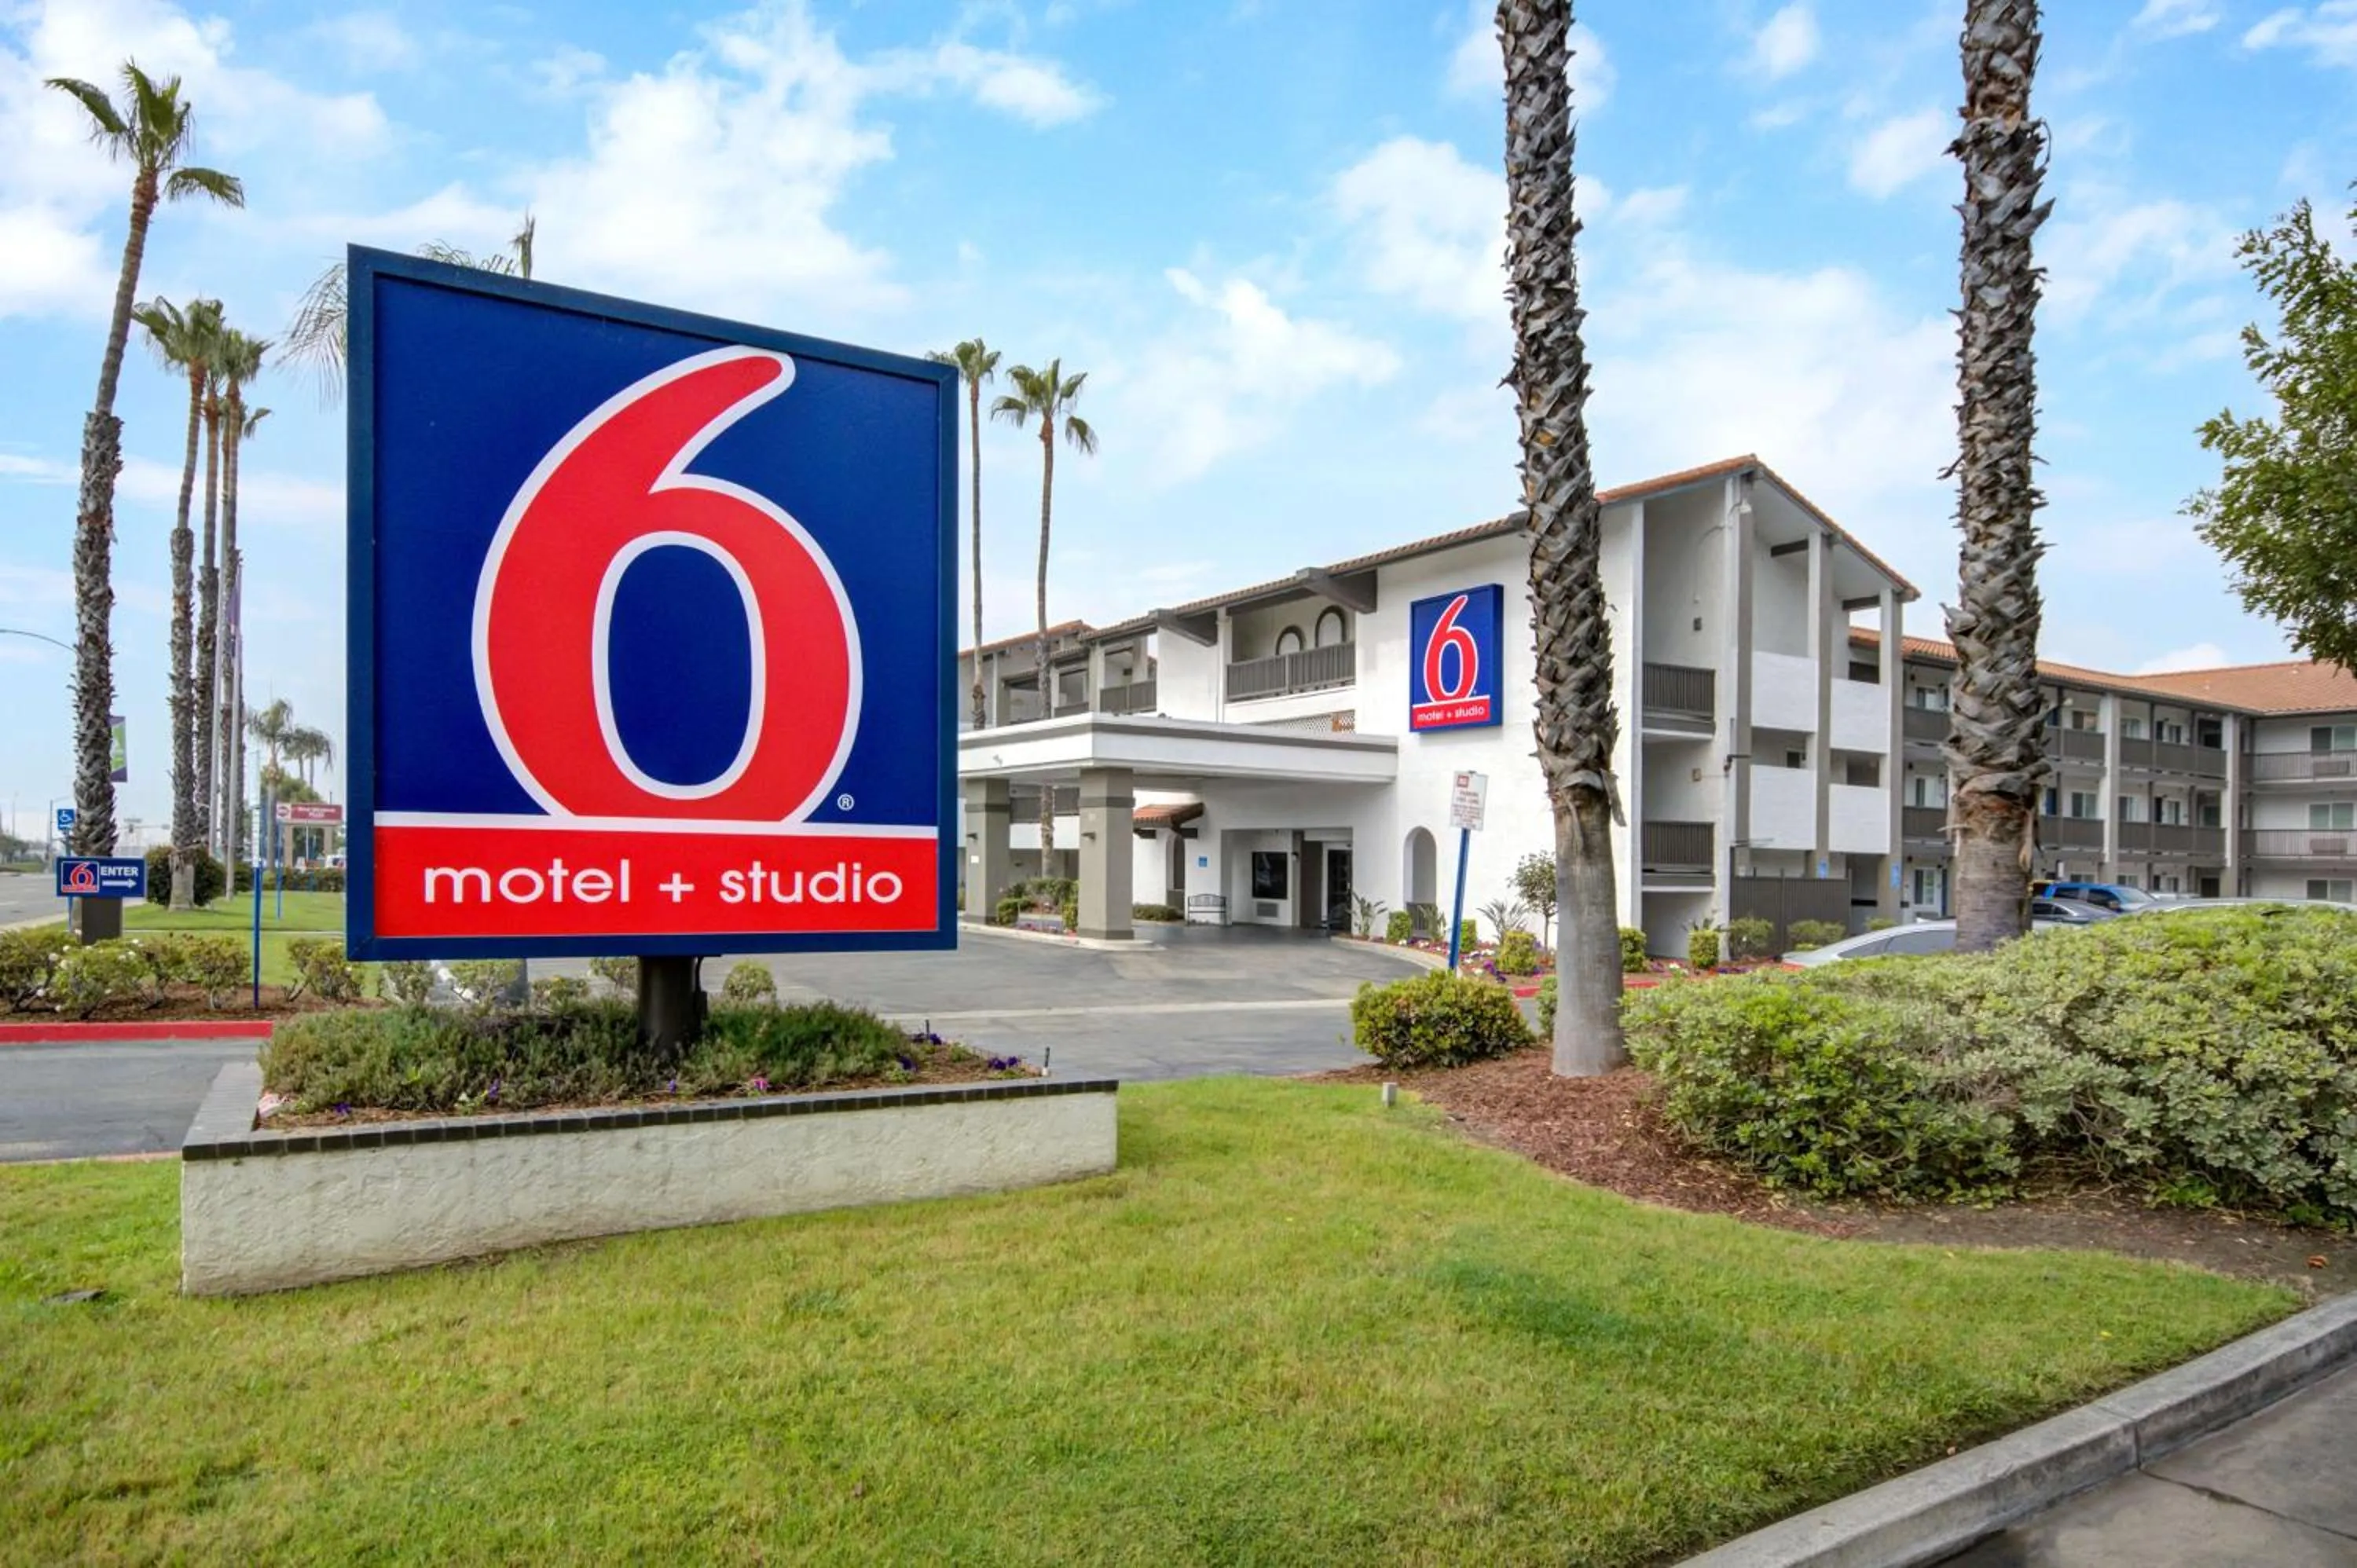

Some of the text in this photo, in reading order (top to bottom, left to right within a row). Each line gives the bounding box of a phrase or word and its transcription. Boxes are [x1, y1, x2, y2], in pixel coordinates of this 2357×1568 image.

[471, 344, 863, 822] 6
[1424, 595, 1479, 703] 6
[1455, 705, 1485, 718] studio
[70, 861, 94, 886] 6
[100, 866, 139, 877] ENTER
[424, 858, 629, 903] motel
[719, 861, 903, 903] studio
